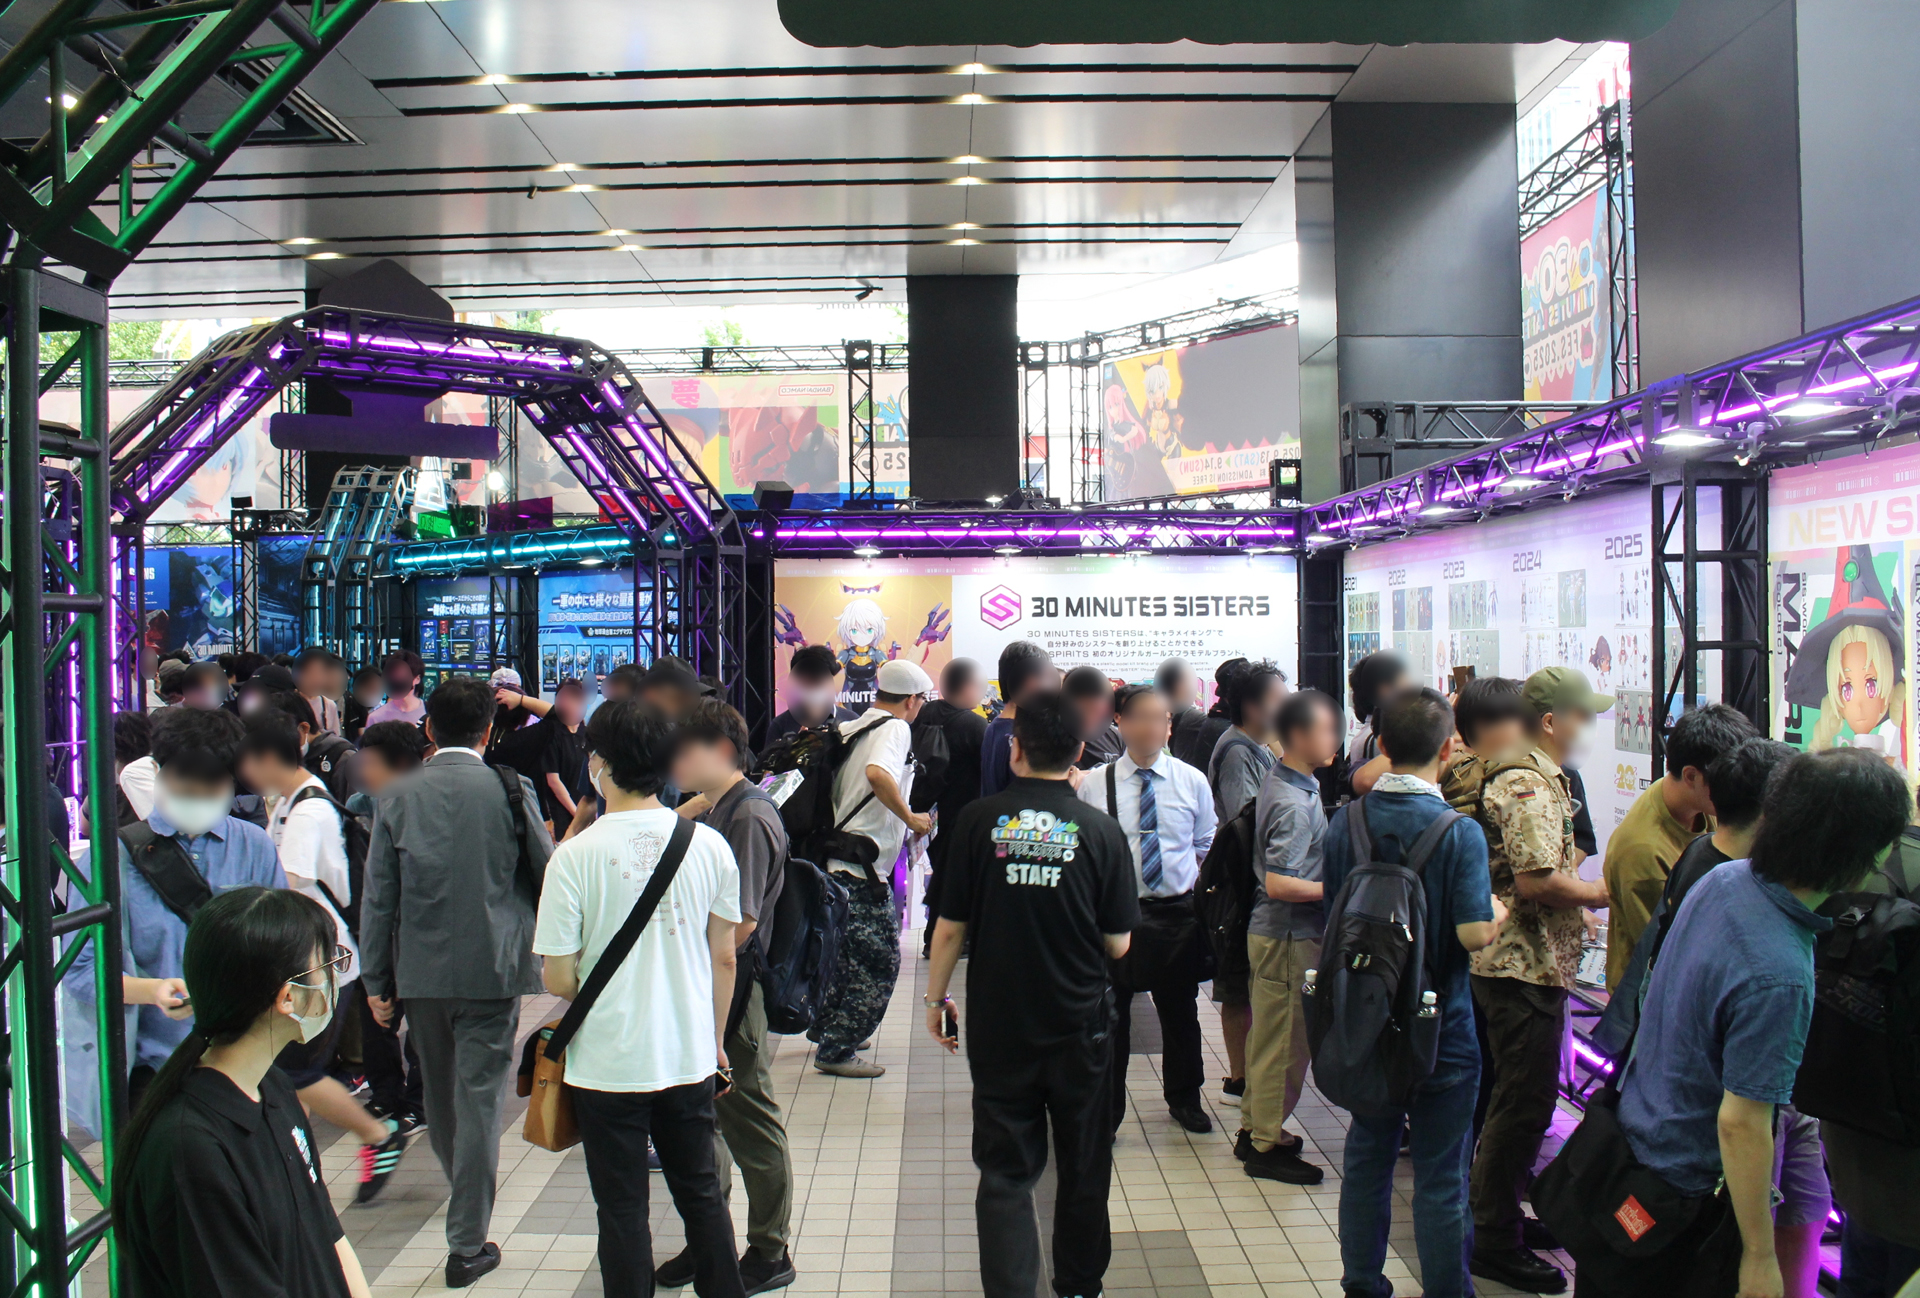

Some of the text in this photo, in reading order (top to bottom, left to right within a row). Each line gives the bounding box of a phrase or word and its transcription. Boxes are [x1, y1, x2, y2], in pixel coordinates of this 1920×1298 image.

[1789, 495, 1920, 546] NEW S
[1605, 534, 1643, 560] 2025
[1443, 560, 1465, 579] 2023
[1513, 550, 1542, 572] 2024
[1344, 577, 1358, 591] 2021
[1389, 569, 1406, 586] 2022
[1031, 595, 1271, 618] 30 MINUTES SISTERS
[1027, 630, 1041, 638] 30
[1044, 630, 1089, 638] MINUTES
[1048, 650, 1089, 659] SPIRITS
[1783, 573, 1803, 750] MARI
[834, 691, 876, 703] MINUTE
[1019, 809, 1056, 832] 30
[1006, 863, 1062, 888] STAFF
